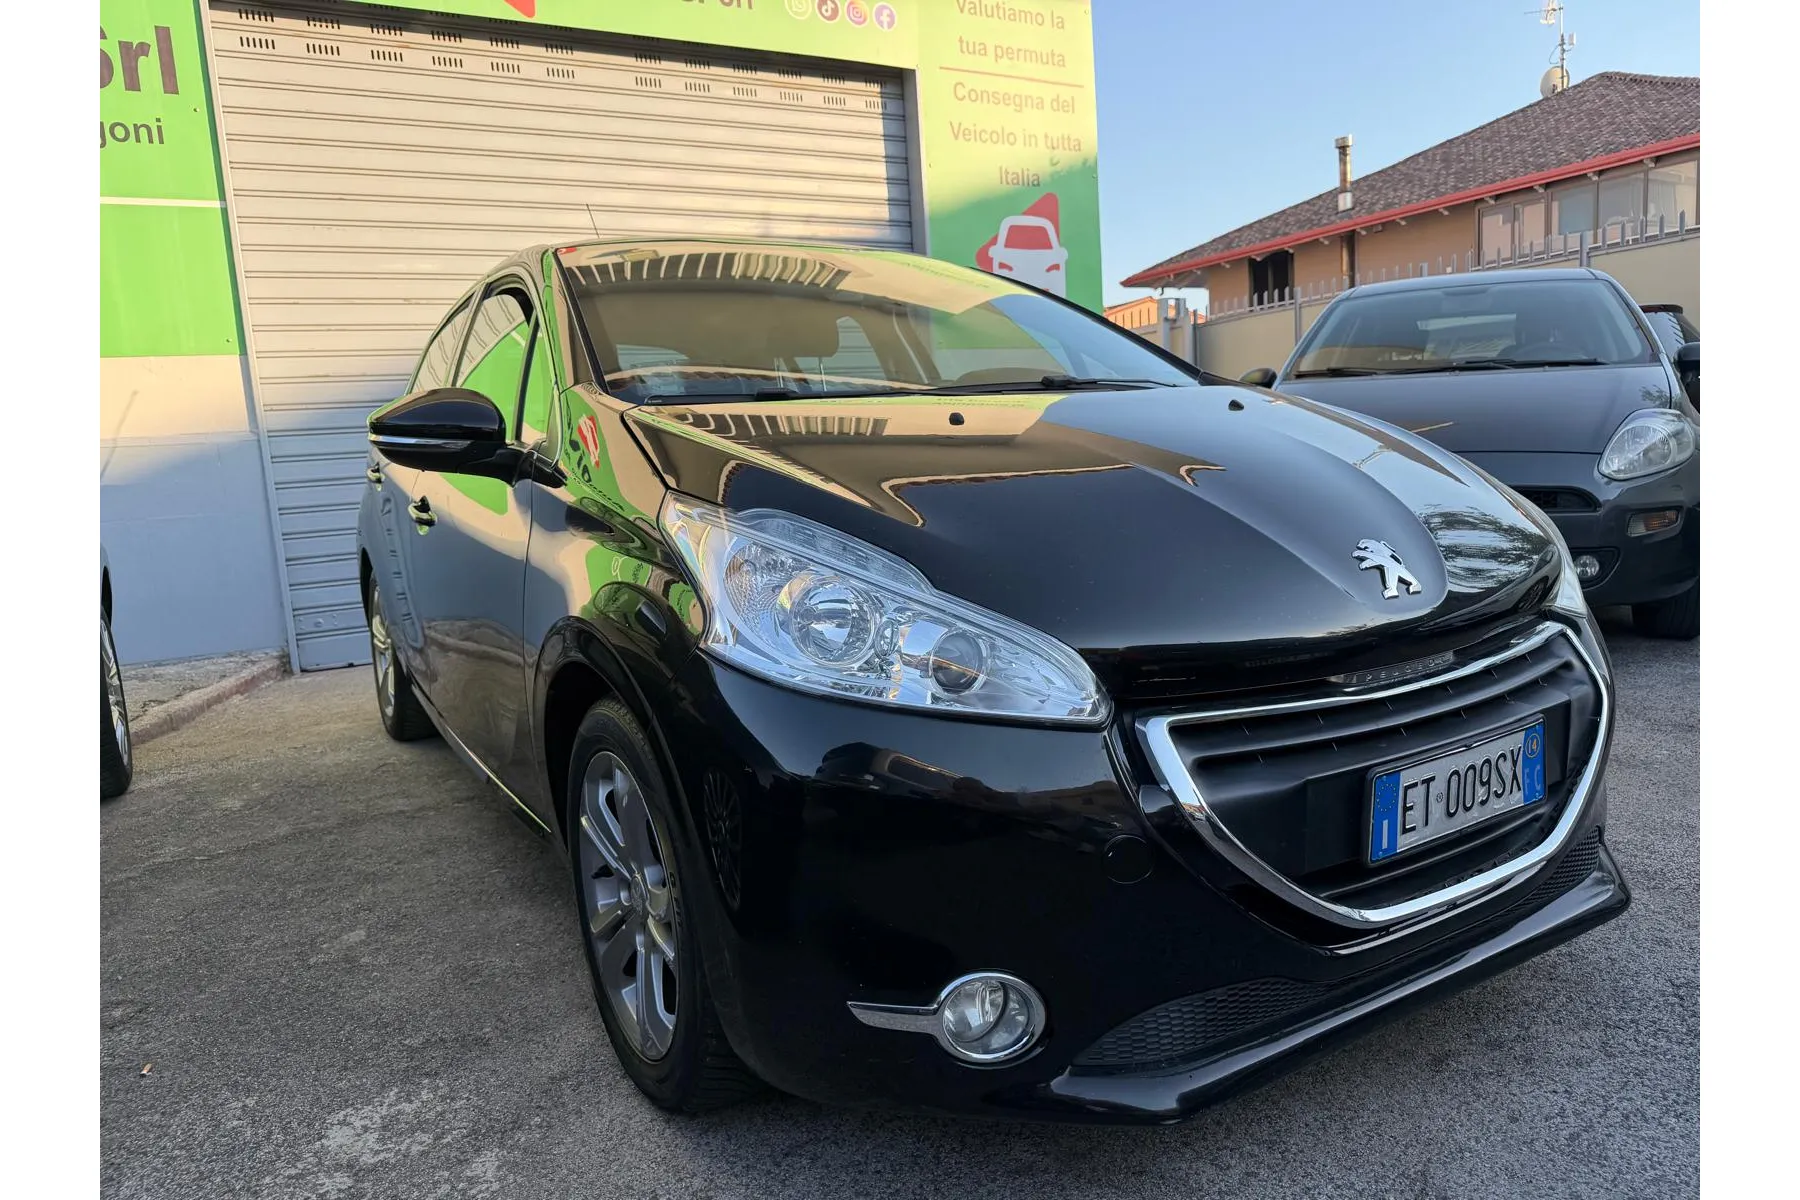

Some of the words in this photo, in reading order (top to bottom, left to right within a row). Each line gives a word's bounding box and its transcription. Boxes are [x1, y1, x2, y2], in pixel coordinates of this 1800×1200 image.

[956, 0, 1045, 26] Valutiamo
[1051, 10, 1065, 30] la
[958, 36, 988, 57] tua
[994, 43, 1066, 68] permuta
[953, 81, 1045, 113] Consegna
[1050, 94, 1075, 114] del
[949, 120, 1017, 146] Veicolo
[1023, 128, 1038, 149] in
[1044, 132, 1082, 152] tutta
[999, 166, 1041, 187] Italia
[1401, 773, 1436, 835] ET
[1446, 745, 1523, 818] 009SX
